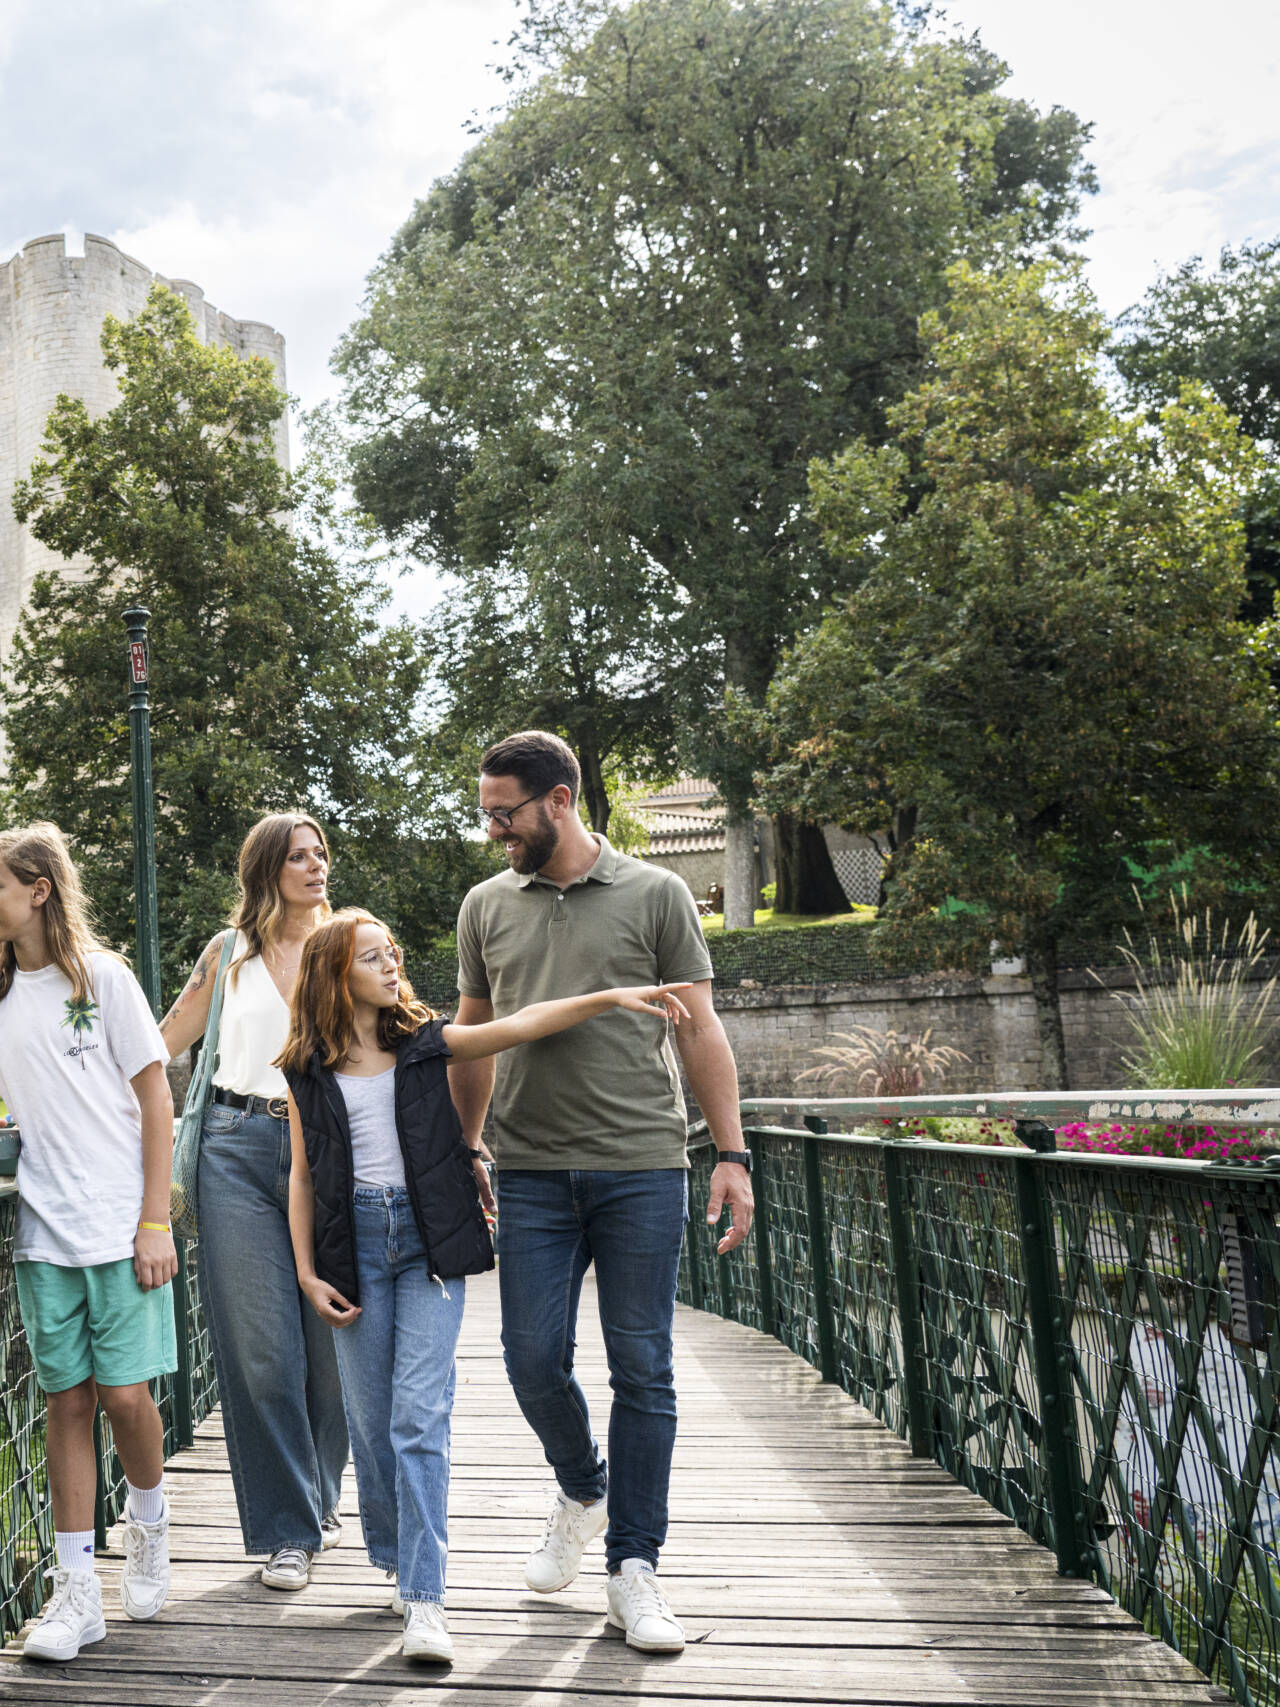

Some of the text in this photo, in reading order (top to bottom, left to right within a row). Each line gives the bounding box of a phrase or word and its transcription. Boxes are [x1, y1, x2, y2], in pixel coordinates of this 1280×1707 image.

[133, 646, 142, 655] 01
[136, 659, 142, 668] 2
[136, 671, 145, 680] 76
